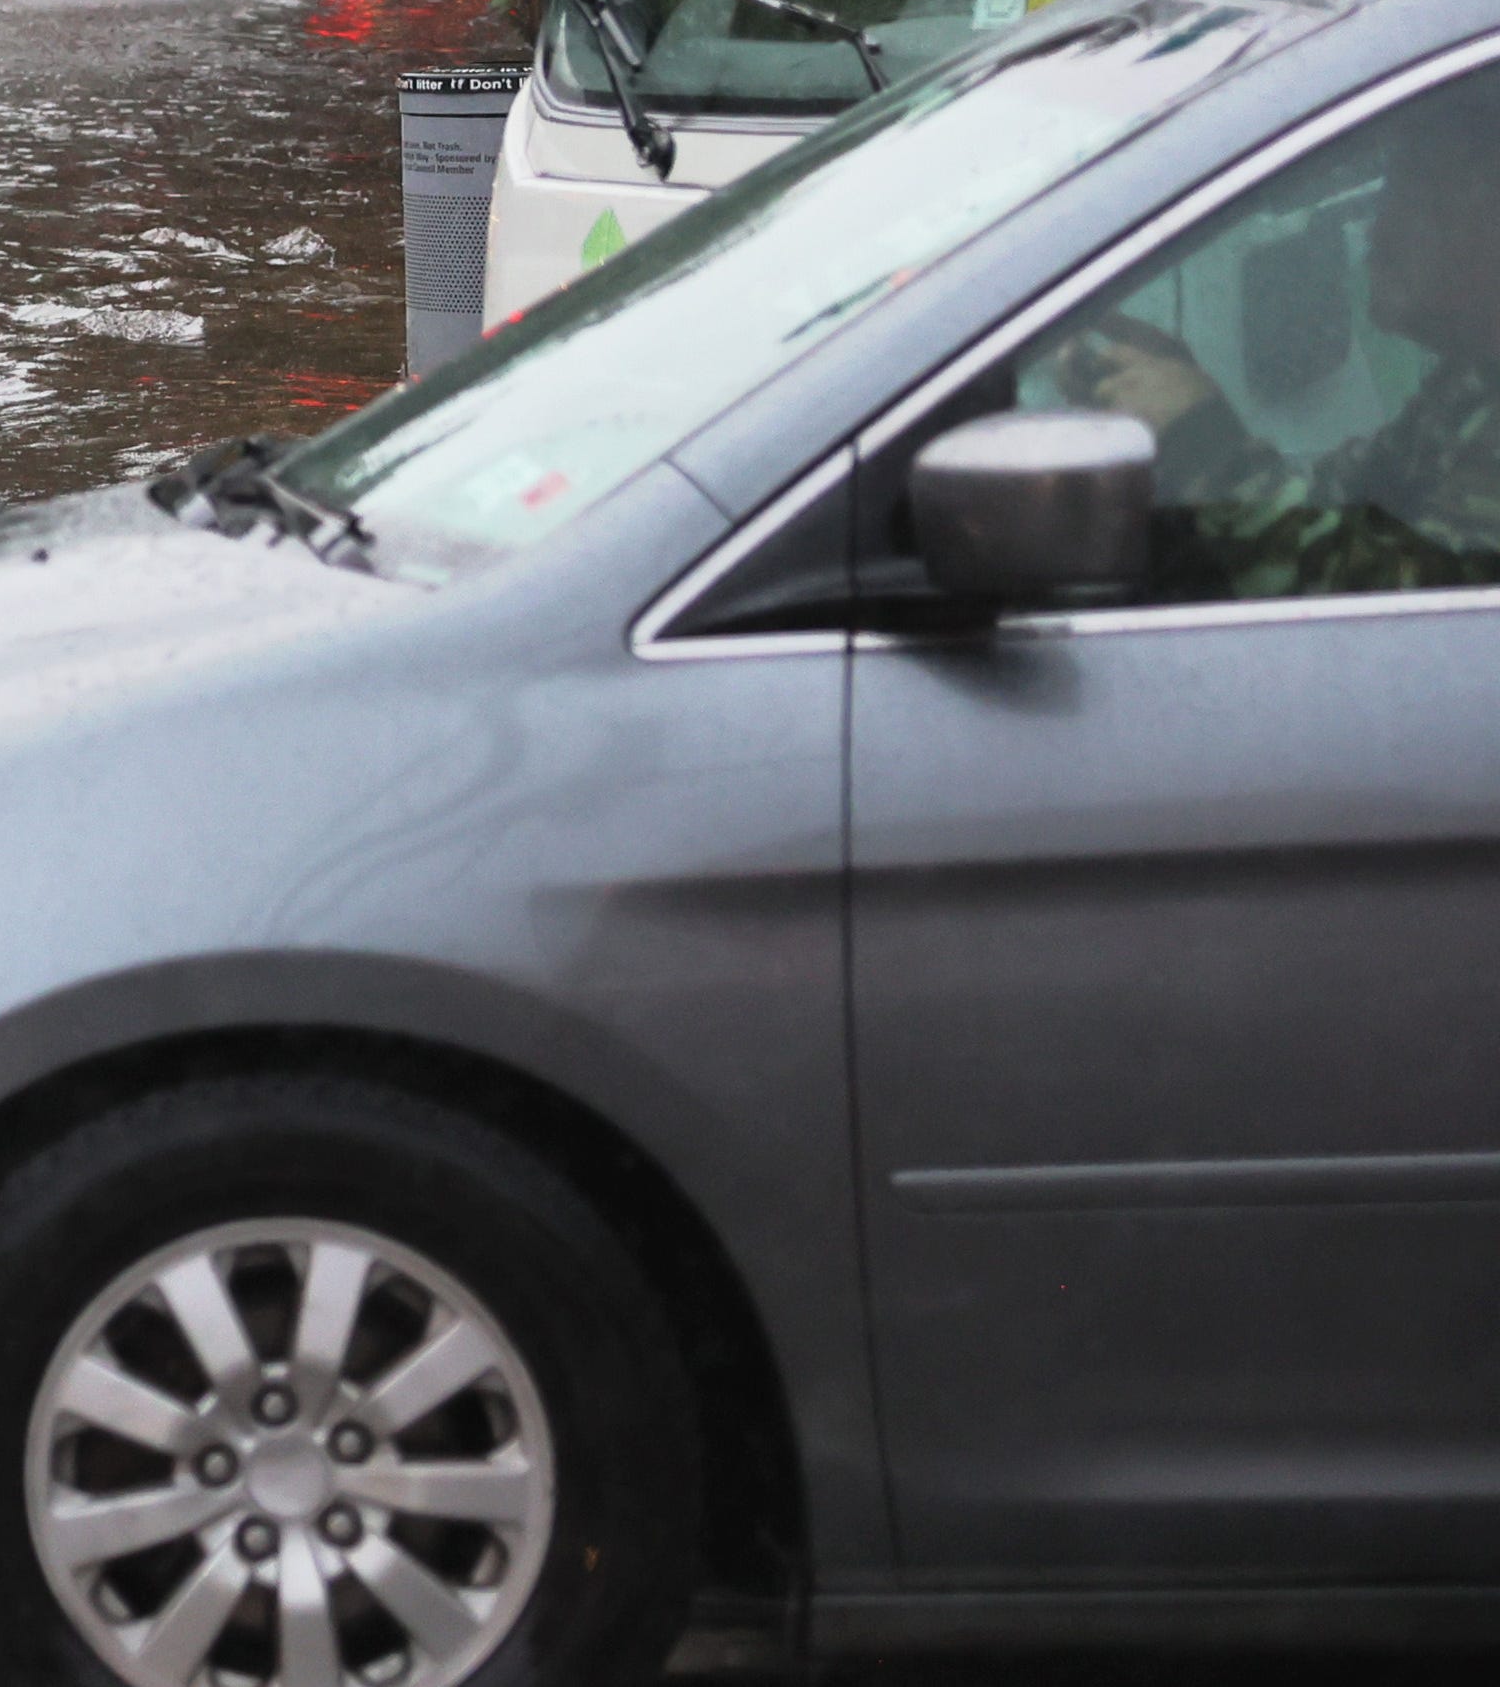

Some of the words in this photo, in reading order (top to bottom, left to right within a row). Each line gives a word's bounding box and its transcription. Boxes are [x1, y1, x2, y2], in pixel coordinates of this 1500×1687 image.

[416, 78, 443, 90] litter
[469, 77, 512, 90] Don't
[436, 164, 475, 175] Member
